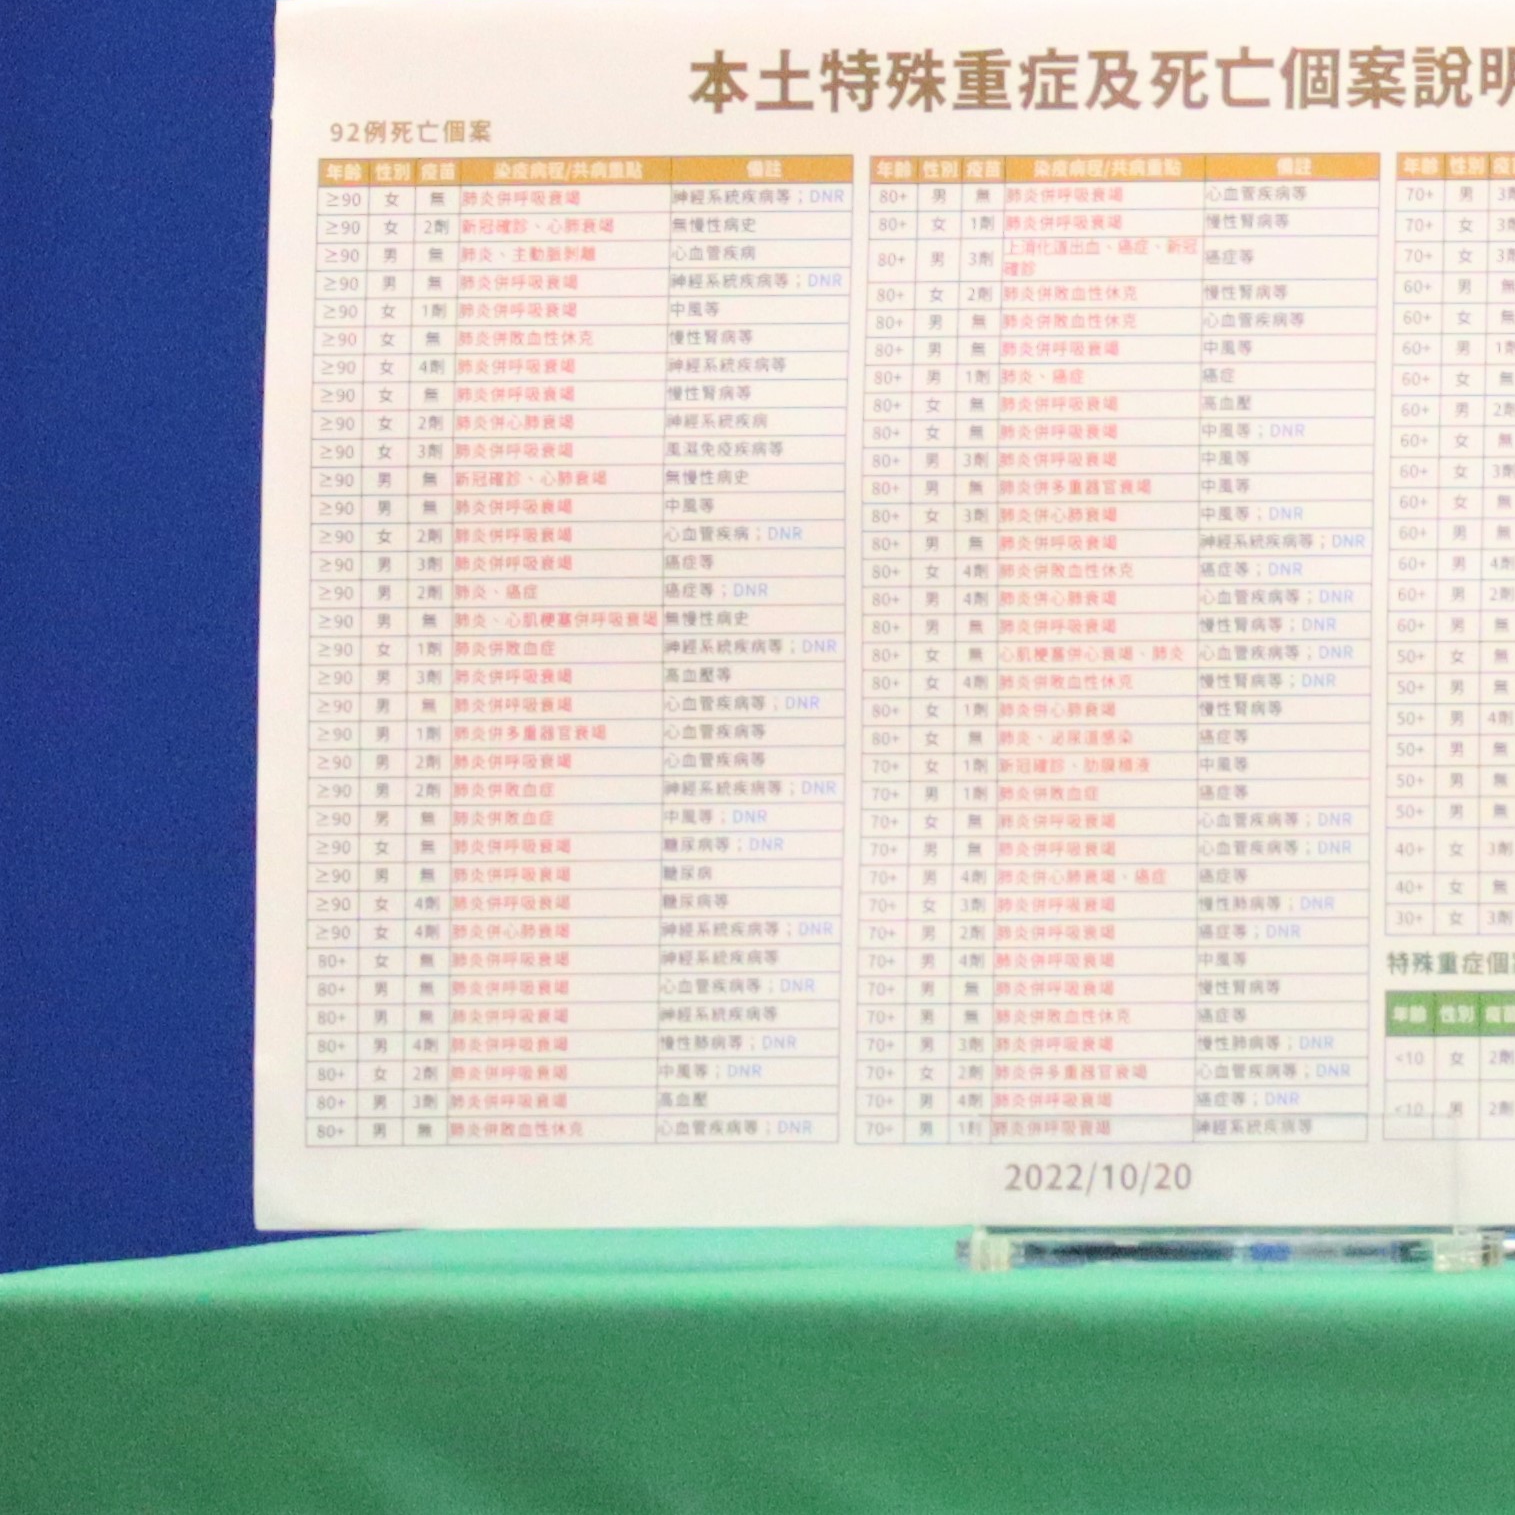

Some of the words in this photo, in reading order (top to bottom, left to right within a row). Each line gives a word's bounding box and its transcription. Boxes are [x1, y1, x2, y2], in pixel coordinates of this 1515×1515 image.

[330, 120, 492, 143] 92例死亡個案
[327, 164, 362, 182] 年齡
[376, 164, 411, 181] 性別
[422, 163, 456, 181] 疫苗
[747, 160, 781, 178] 備註
[877, 161, 911, 178] 年齡
[923, 161, 958, 177] 性別
[966, 160, 1001, 177] 疫苗
[1276, 158, 1312, 175] 備註
[1403, 157, 1438, 175] 年齡
[1449, 157, 1486, 175] 性別
[326, 192, 362, 208] ≥90
[385, 192, 400, 207] 女
[430, 192, 445, 205] 無
[879, 189, 907, 205] 80+
[932, 189, 947, 204] 男
[976, 188, 991, 202] 無
[1406, 187, 1435, 202] 70+
[1460, 187, 1474, 202] 男
[325, 220, 362, 236] ≥90
[383, 220, 399, 236] 女
[424, 219, 450, 235] 2劑
[1405, 217, 1435, 233] 70+
[1458, 217, 1474, 234] 女
[325, 248, 361, 264] ≥90
[384, 247, 398, 263] 男
[428, 247, 444, 263] 無
[875, 287, 905, 304] 80+
[929, 287, 945, 303] 女
[967, 286, 993, 303] 2劑
[1402, 310, 1433, 326] 60+
[1456, 310, 1472, 326] 女
[1500, 309, 1515, 325] 無
[322, 332, 359, 348] ≥90
[380, 332, 396, 347] 女
[426, 331, 441, 346] 無
[873, 371, 903, 386] 80+
[926, 368, 942, 386] 男
[964, 369, 991, 384] 1劑
[1203, 366, 1237, 385] 癌症
[1400, 371, 1432, 387] 60+
[1456, 371, 1471, 388] 女
[1499, 371, 1515, 387] 無
[320, 444, 356, 461] ≥90
[377, 444, 393, 461] 女
[417, 443, 444, 460] 3劑
[318, 585, 356, 602] ≥90
[377, 584, 392, 601] 男
[417, 585, 443, 601] 2劑
[871, 592, 901, 608] 80+
[926, 591, 940, 608] 男
[963, 591, 989, 607] 4劑
[1397, 586, 1427, 603] 60+
[1451, 585, 1466, 602] 男
[1490, 586, 1515, 602] 2劑
[317, 670, 354, 687] ≥90
[377, 669, 391, 686] 男
[415, 669, 442, 685] 3劑
[1450, 1051, 1464, 1065] 女
[1004, 1161, 1192, 1196] 2022/10/20
